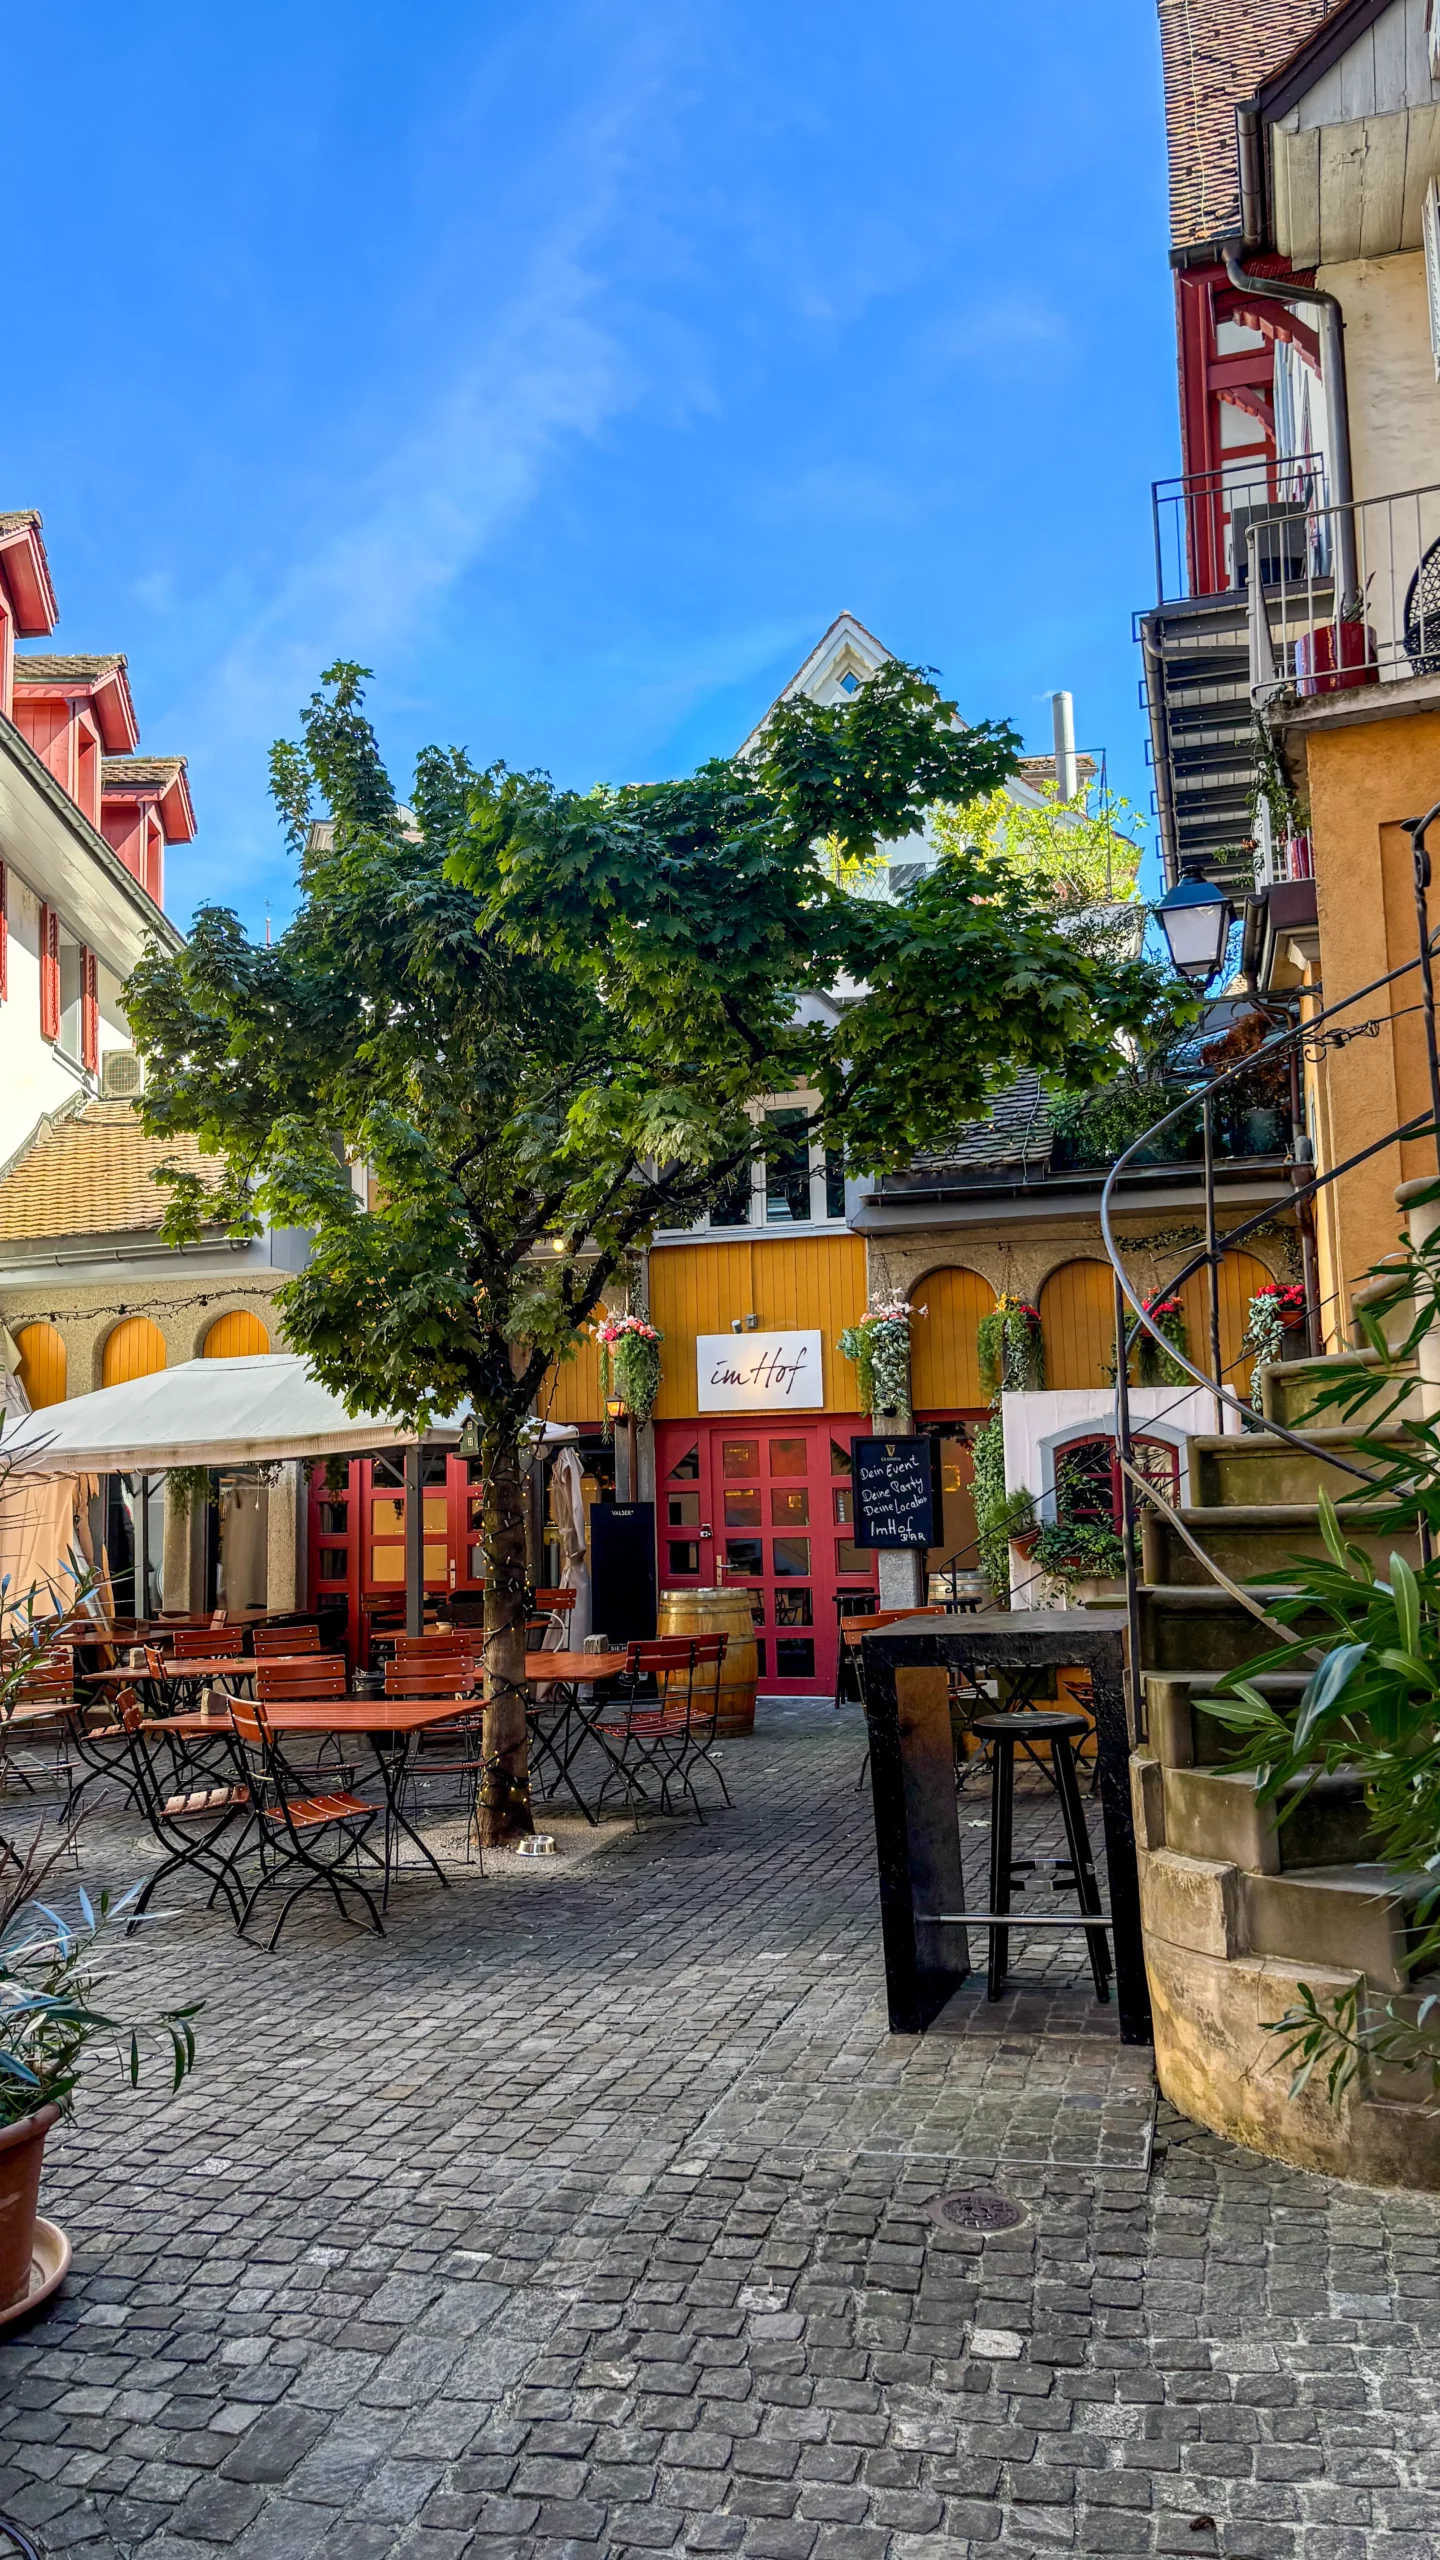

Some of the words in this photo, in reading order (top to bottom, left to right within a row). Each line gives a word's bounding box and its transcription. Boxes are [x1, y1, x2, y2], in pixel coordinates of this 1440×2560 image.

[860, 1465, 884, 1480] Dein
[886, 1455, 919, 1477] Event
[862, 1486, 891, 1502] Deine
[890, 1476, 924, 1493] Party
[863, 1503, 894, 1516] Deine
[894, 1494, 928, 1514] Location
[900, 1533, 926, 1541] BAR
